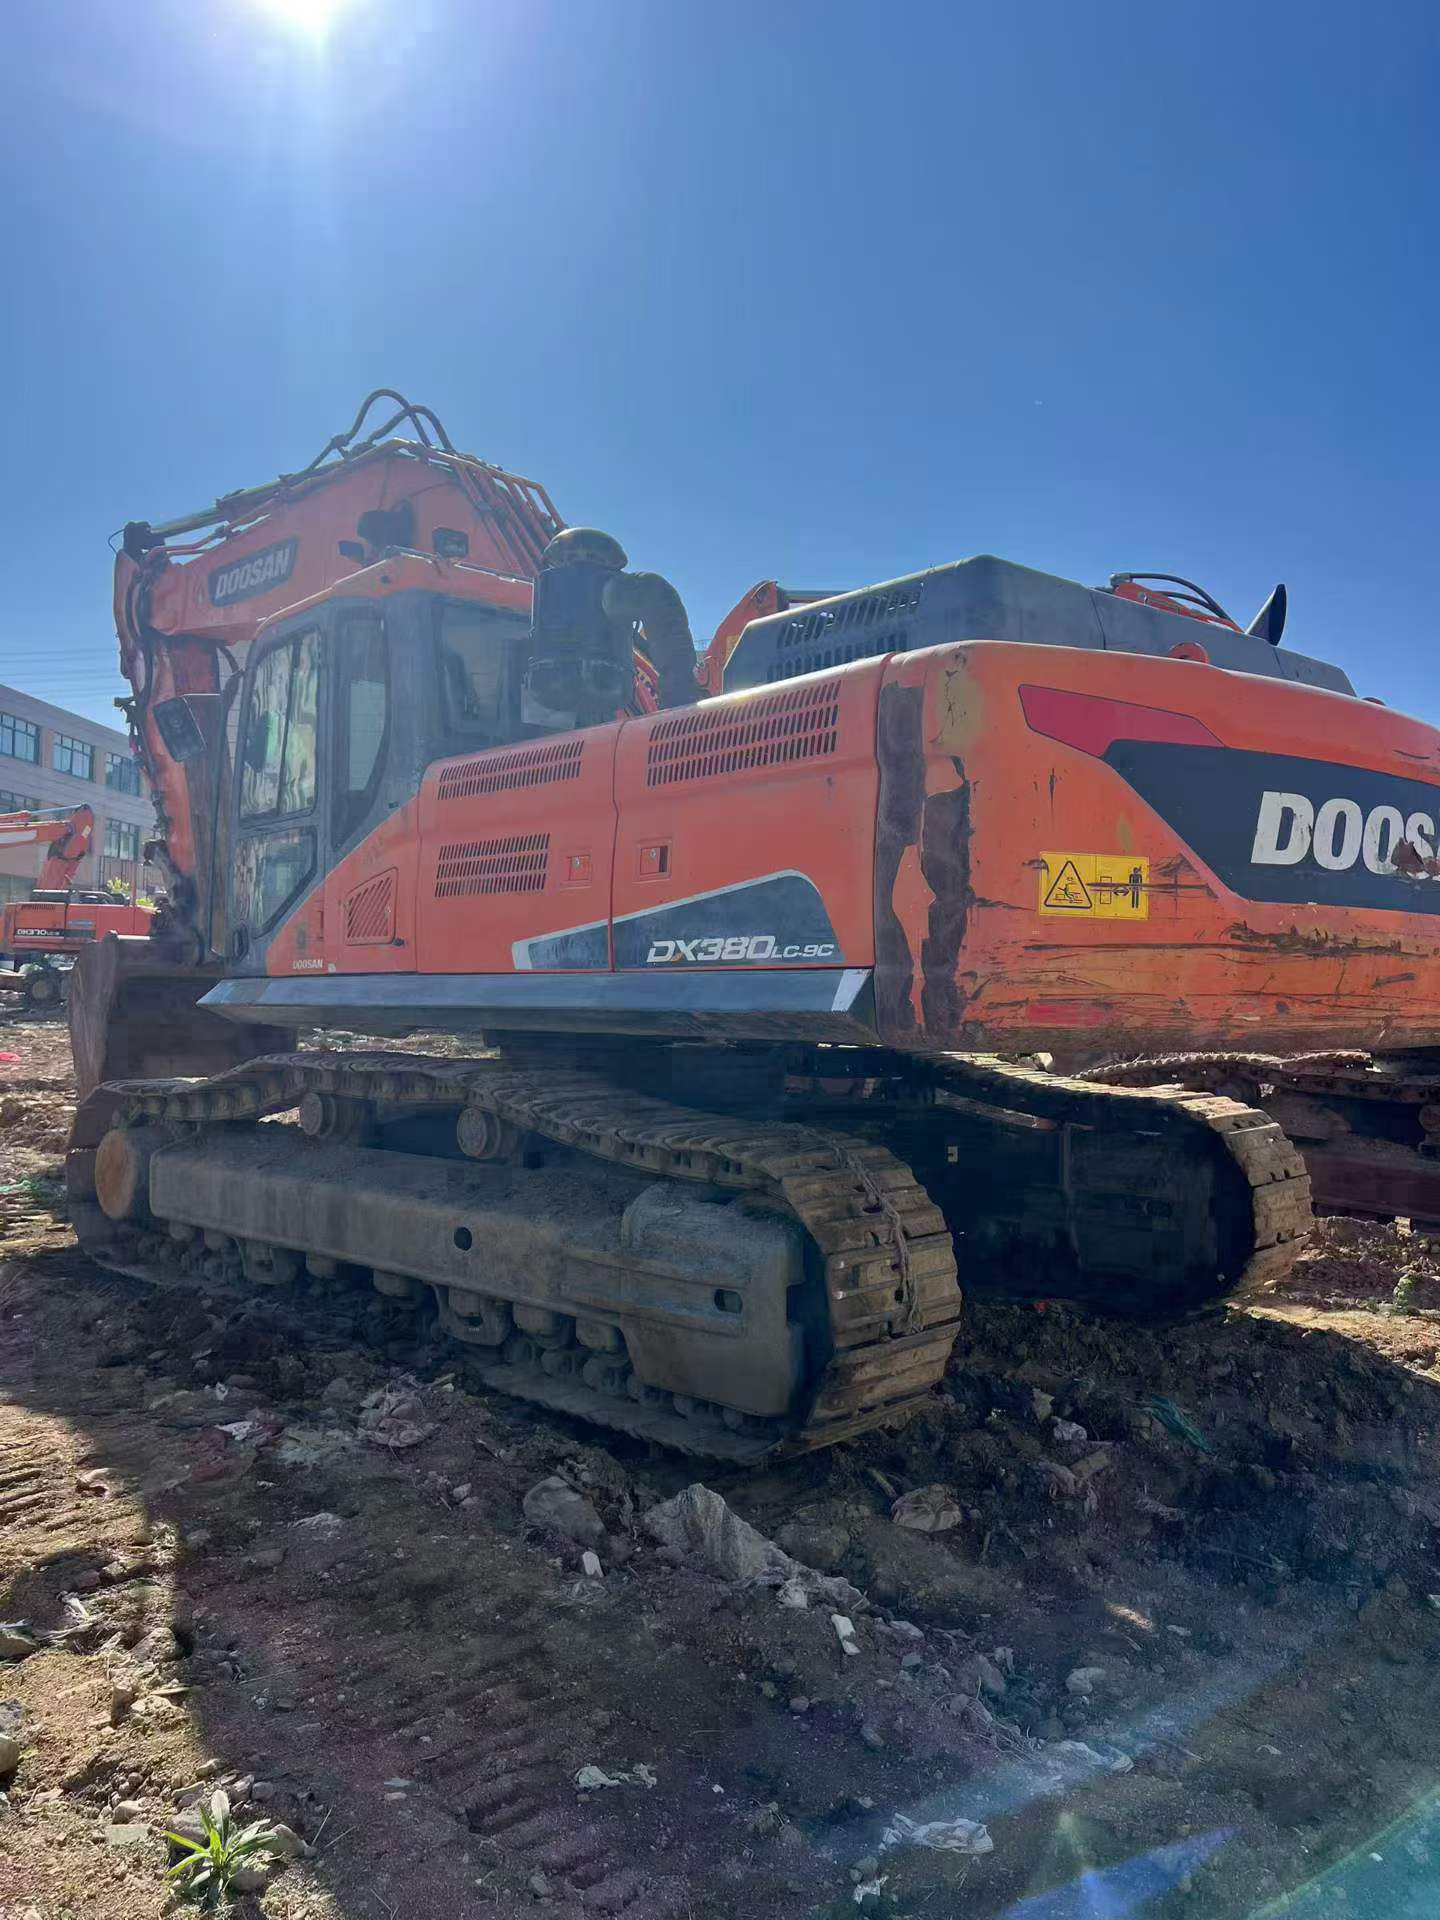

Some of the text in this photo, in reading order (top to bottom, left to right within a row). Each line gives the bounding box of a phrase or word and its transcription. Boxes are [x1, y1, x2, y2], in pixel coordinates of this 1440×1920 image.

[215, 547, 290, 600] DOOSAN
[1250, 791, 1440, 881] DOOS
[292, 959, 323, 970] DOOSAN
